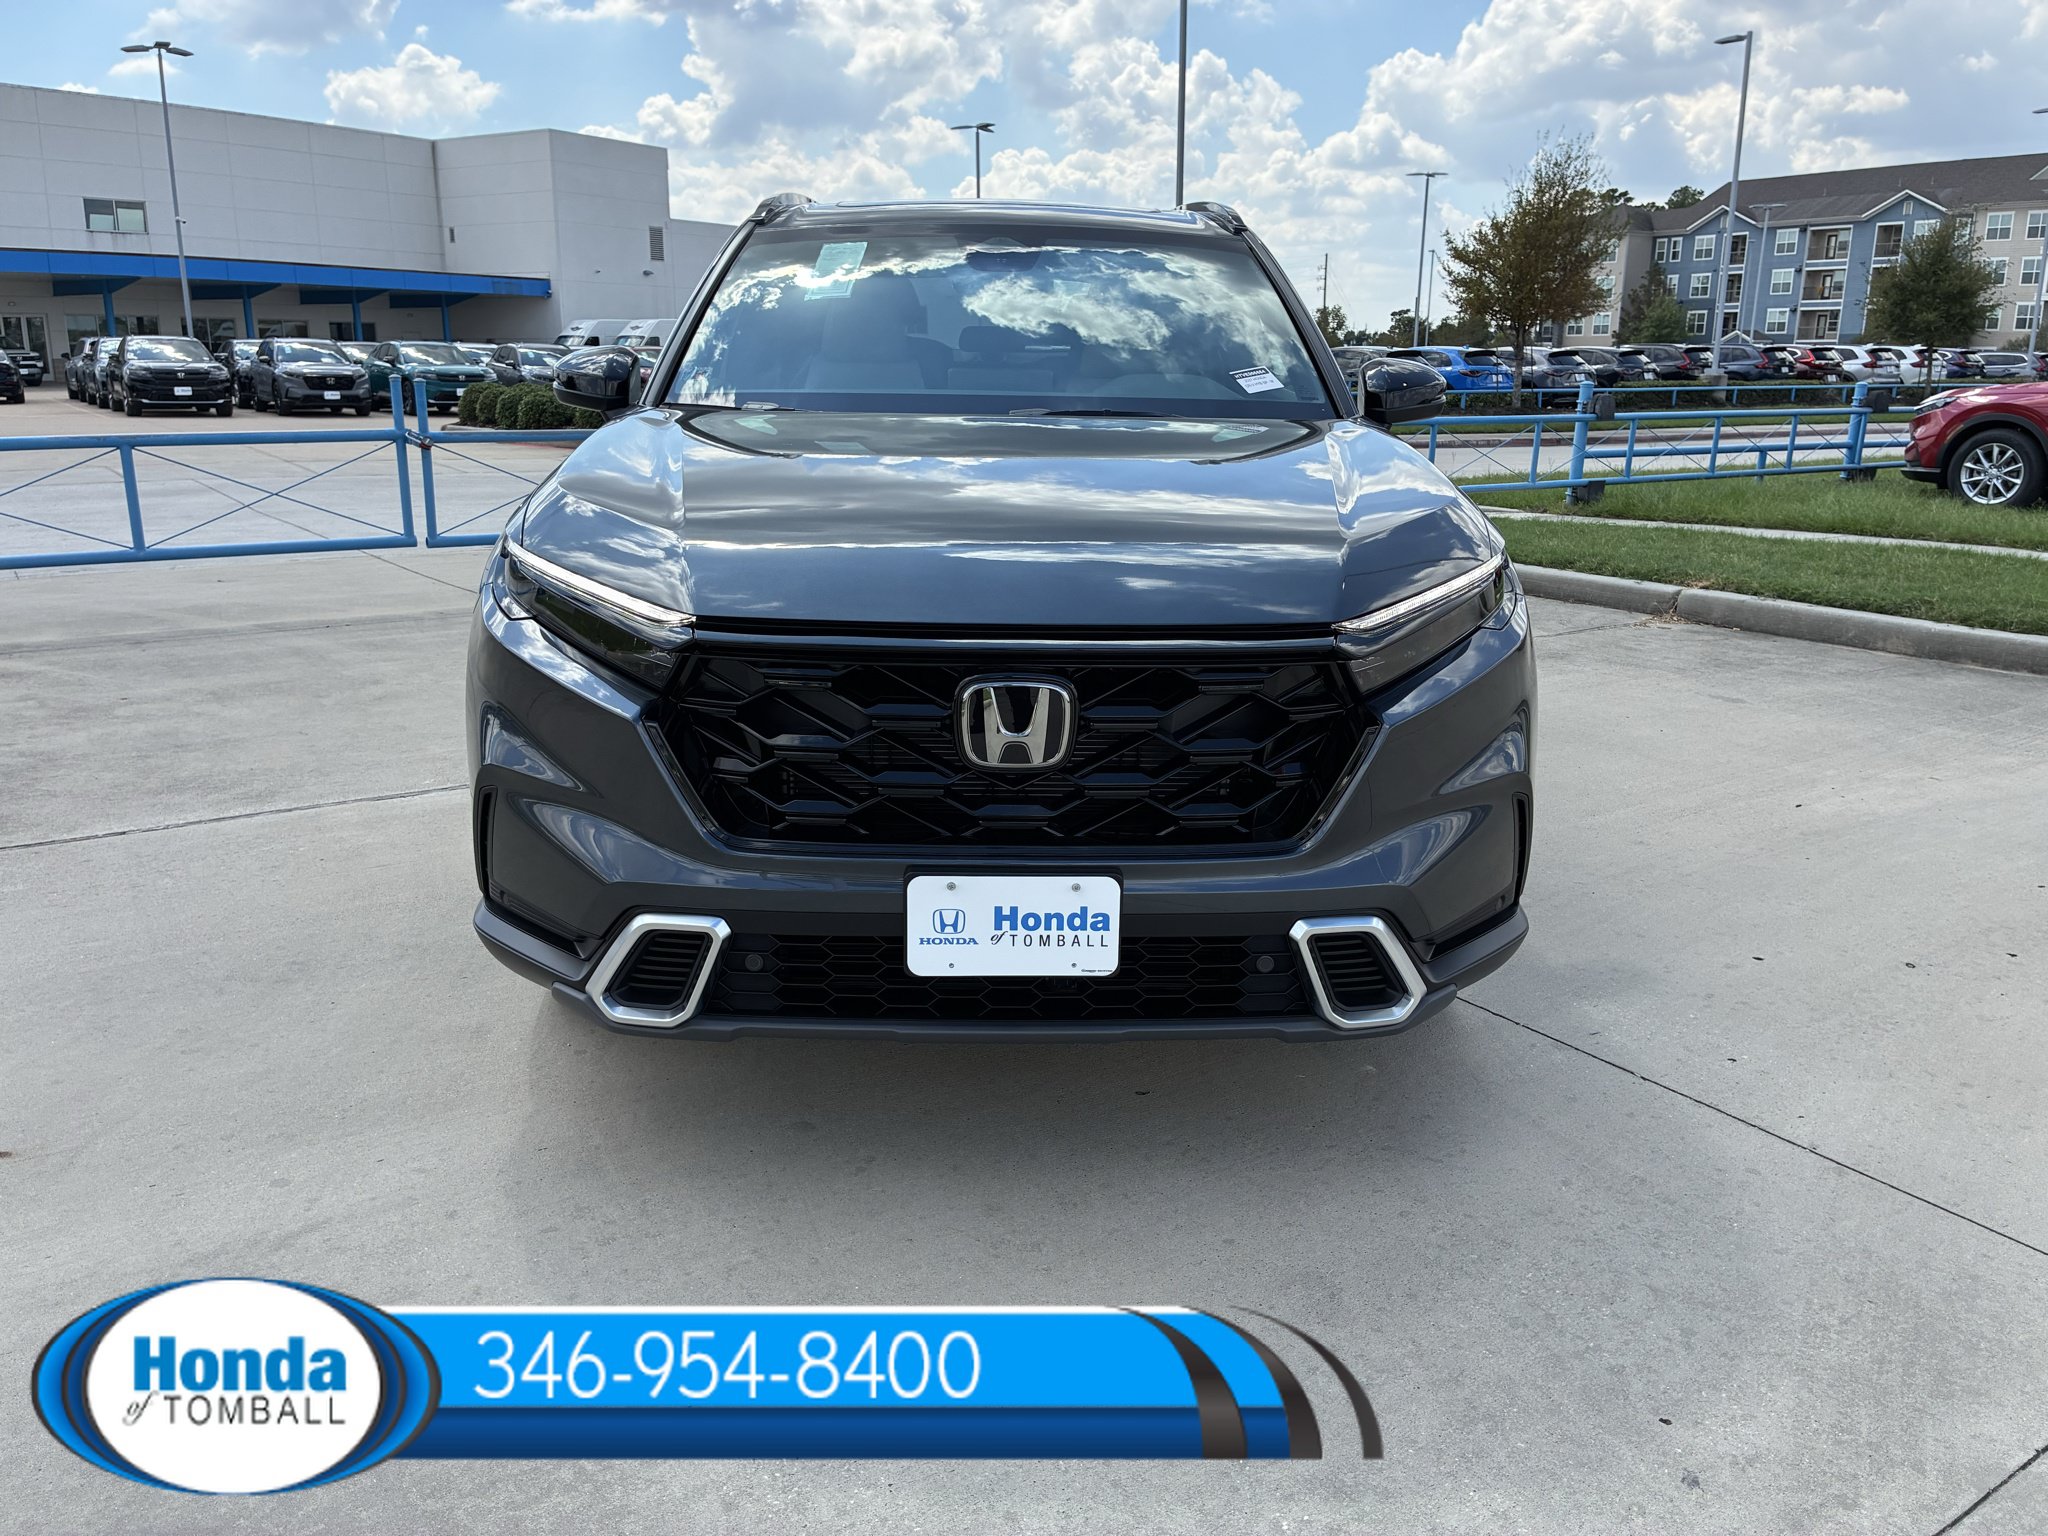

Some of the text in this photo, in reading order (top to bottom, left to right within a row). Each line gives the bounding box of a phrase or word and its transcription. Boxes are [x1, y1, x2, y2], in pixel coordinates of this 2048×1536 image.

[994, 906, 1110, 931] Honda
[991, 930, 1108, 947] of TOMBALL
